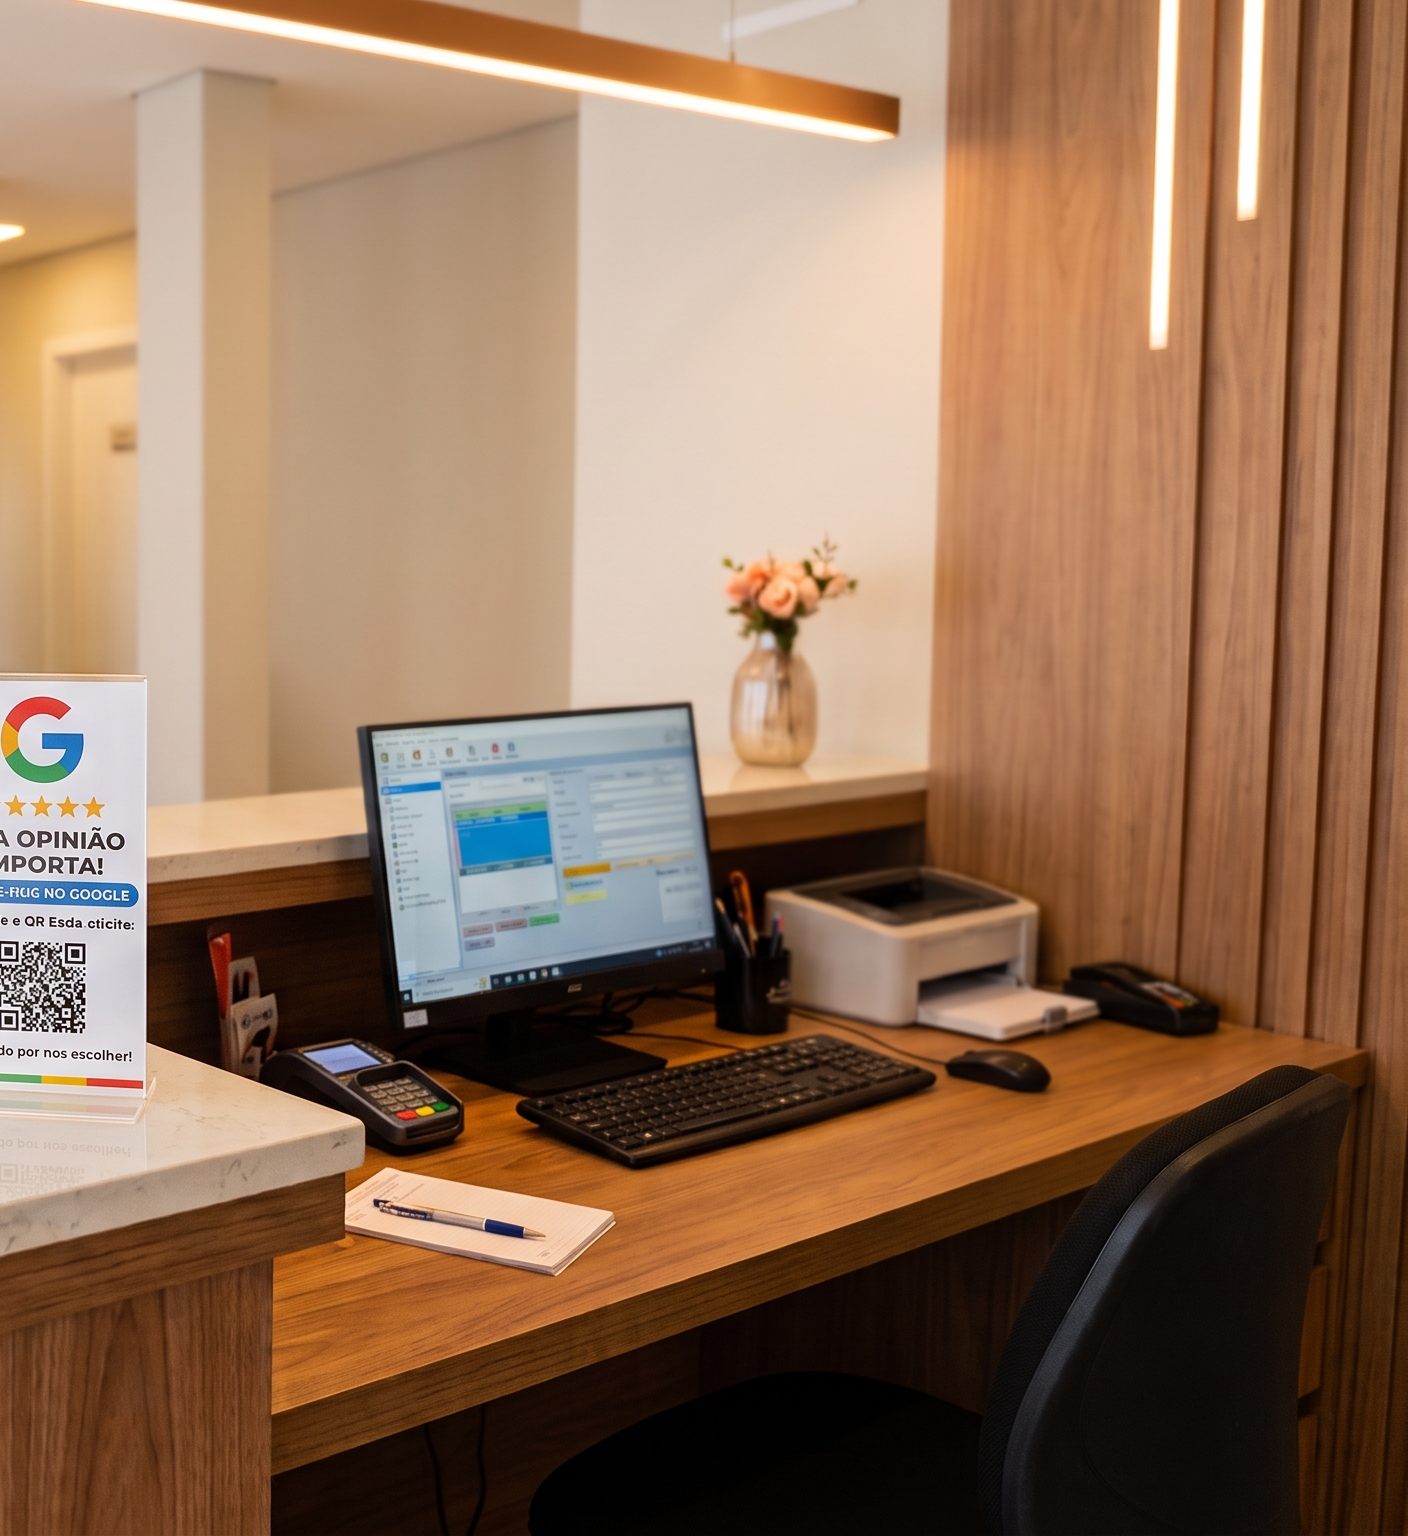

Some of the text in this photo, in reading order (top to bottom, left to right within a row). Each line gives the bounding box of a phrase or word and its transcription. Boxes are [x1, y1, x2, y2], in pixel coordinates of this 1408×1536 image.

[0, 696, 84, 783] G
[16, 827, 126, 851] OPINIÃO
[44, 887, 66, 899] NO
[69, 888, 130, 902] GOOGLE
[12, 917, 21, 926] e
[24, 915, 45, 927] QR
[17, 1047, 40, 1059] por
[43, 1048, 68, 1059] nos
[70, 1050, 133, 1062] escolher!
